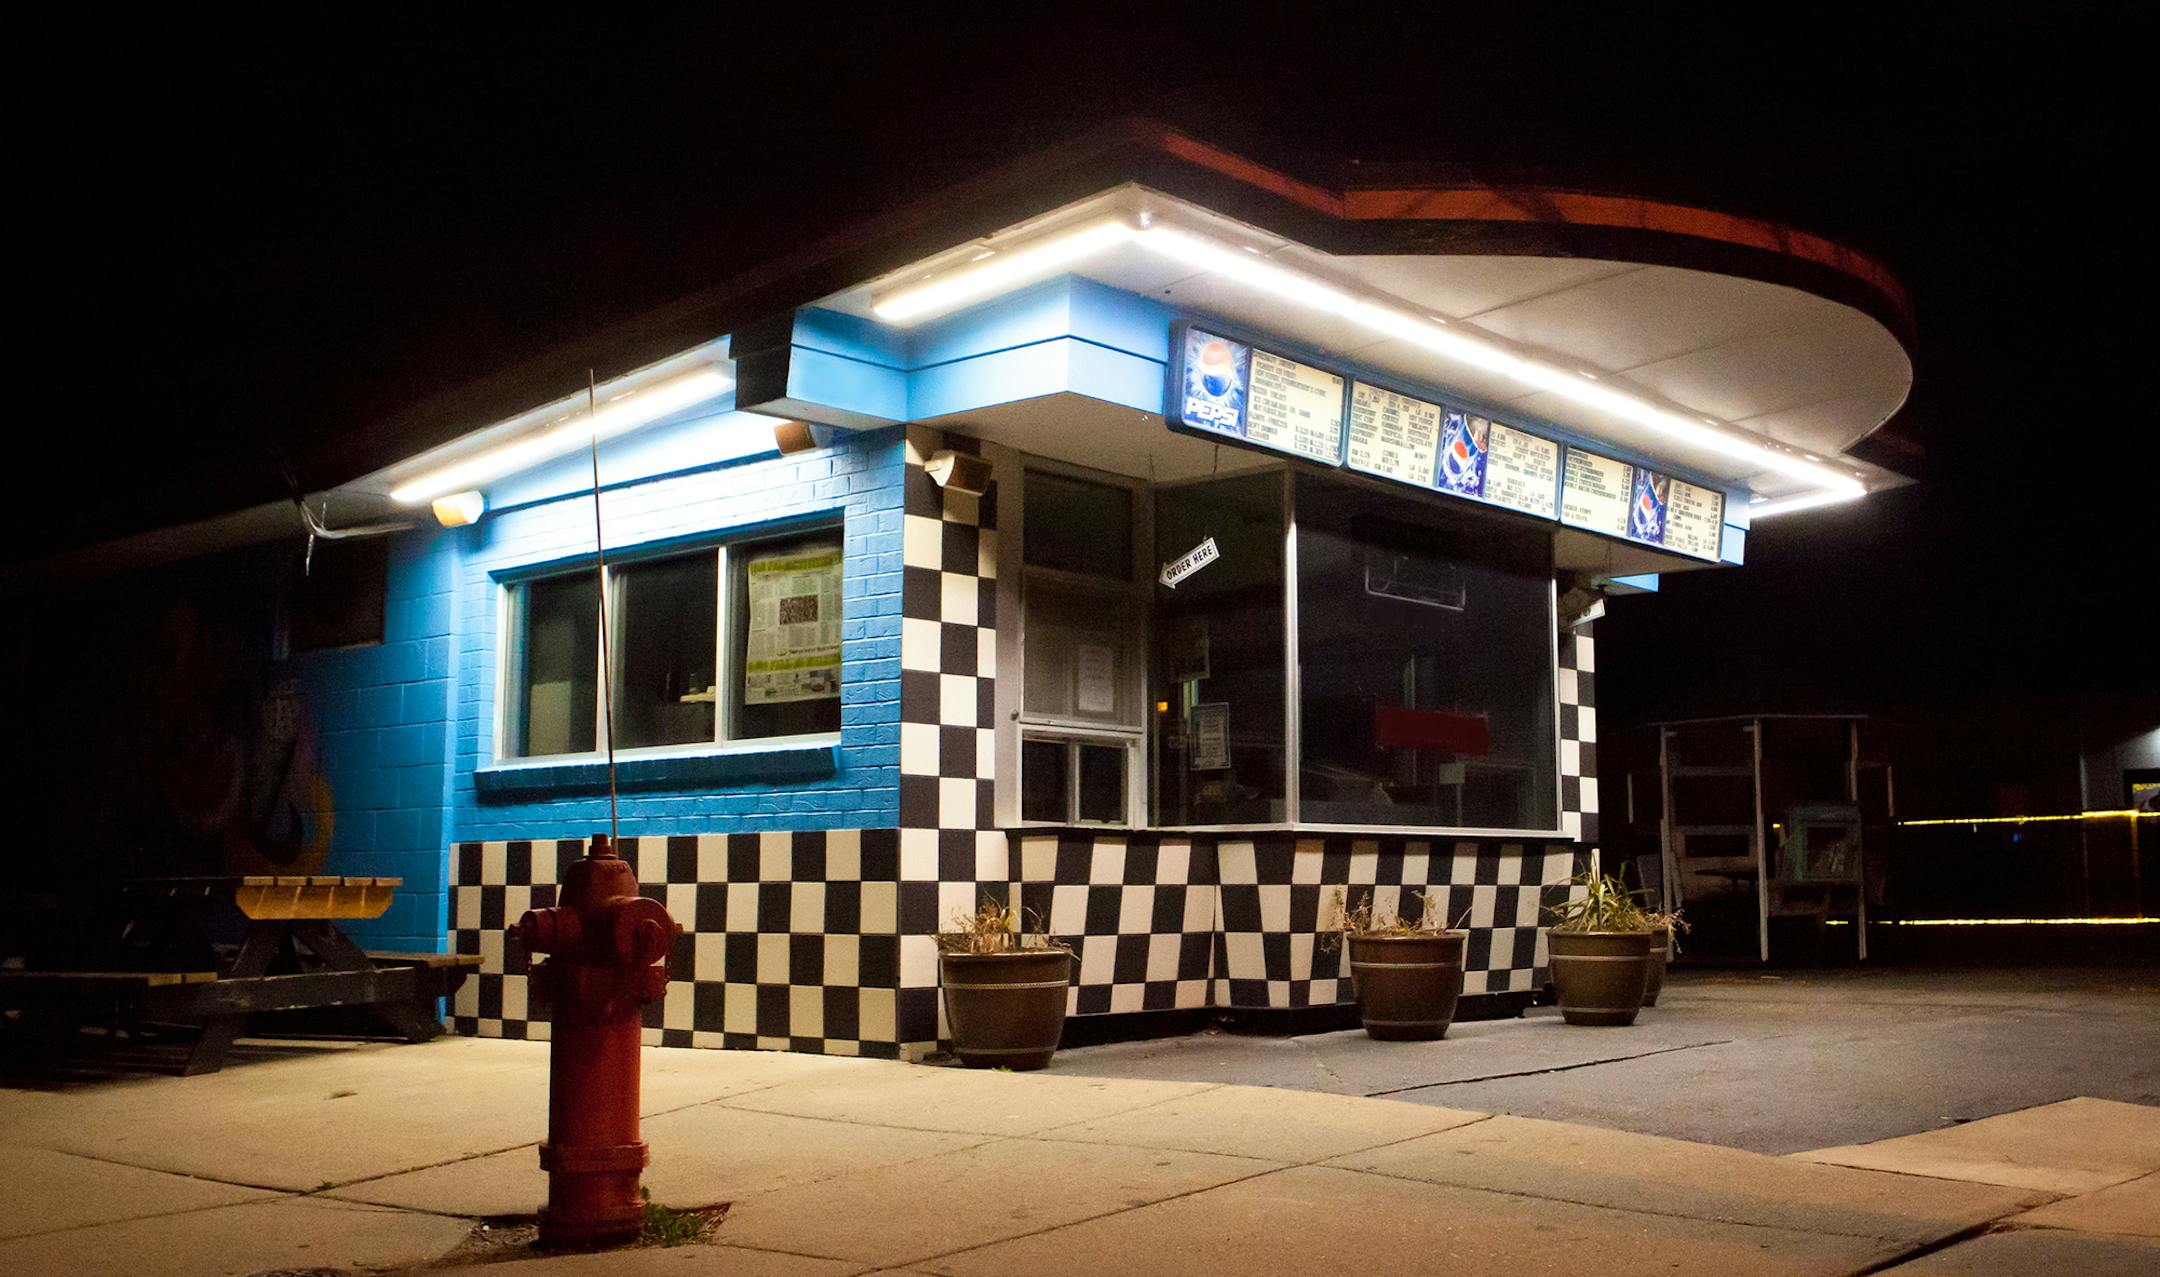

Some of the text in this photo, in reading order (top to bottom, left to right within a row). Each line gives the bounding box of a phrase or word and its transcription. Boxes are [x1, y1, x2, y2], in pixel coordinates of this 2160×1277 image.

[1185, 396, 1239, 427] PEPSI
[1166, 545, 1213, 580] ORDER HERE
